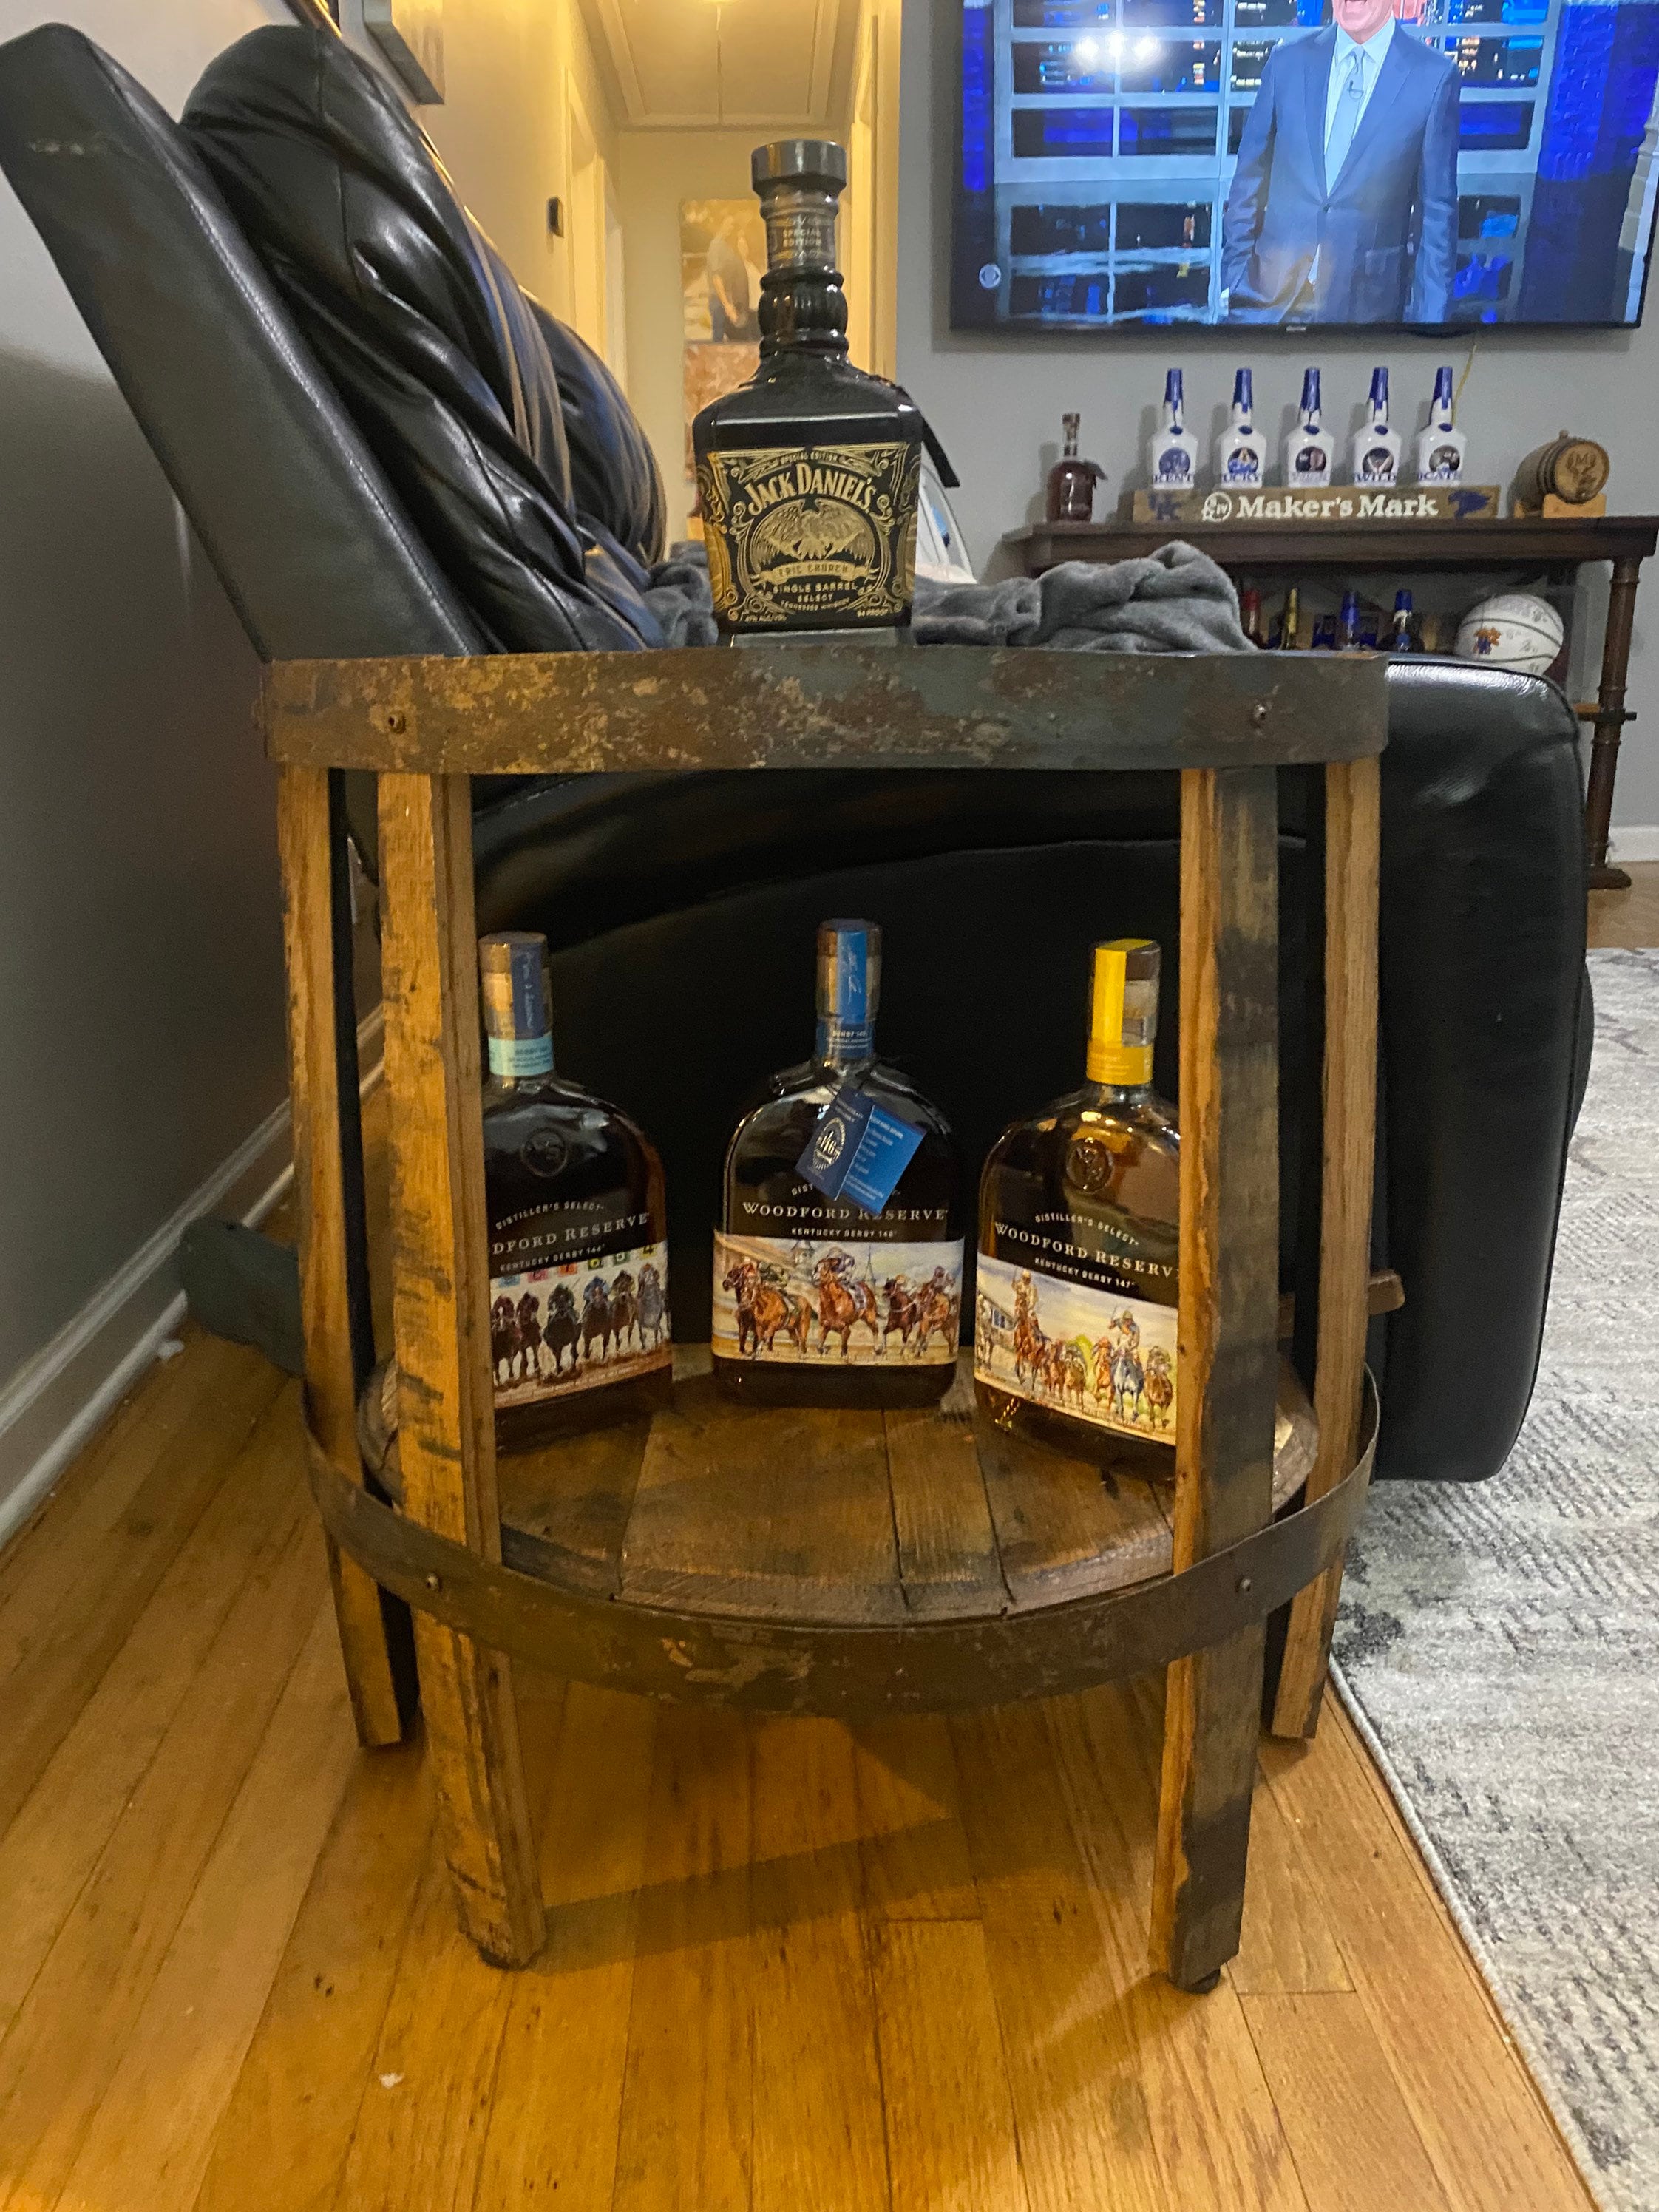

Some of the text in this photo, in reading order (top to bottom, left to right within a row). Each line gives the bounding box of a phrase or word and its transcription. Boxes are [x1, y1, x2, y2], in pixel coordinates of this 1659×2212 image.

[744, 461, 878, 515] JACK DANIEL'S
[1235, 494, 1439, 518] Maker's Mark
[495, 1201, 560, 1230] DISTILLER'S
[742, 1201, 949, 1221] WOODFORD RSERVE
[1035, 1212, 1094, 1227] DISTILLER'S
[492, 1214, 648, 1255] DFORD RESERVE
[994, 1221, 1179, 1280] WOODFORD RESERV
